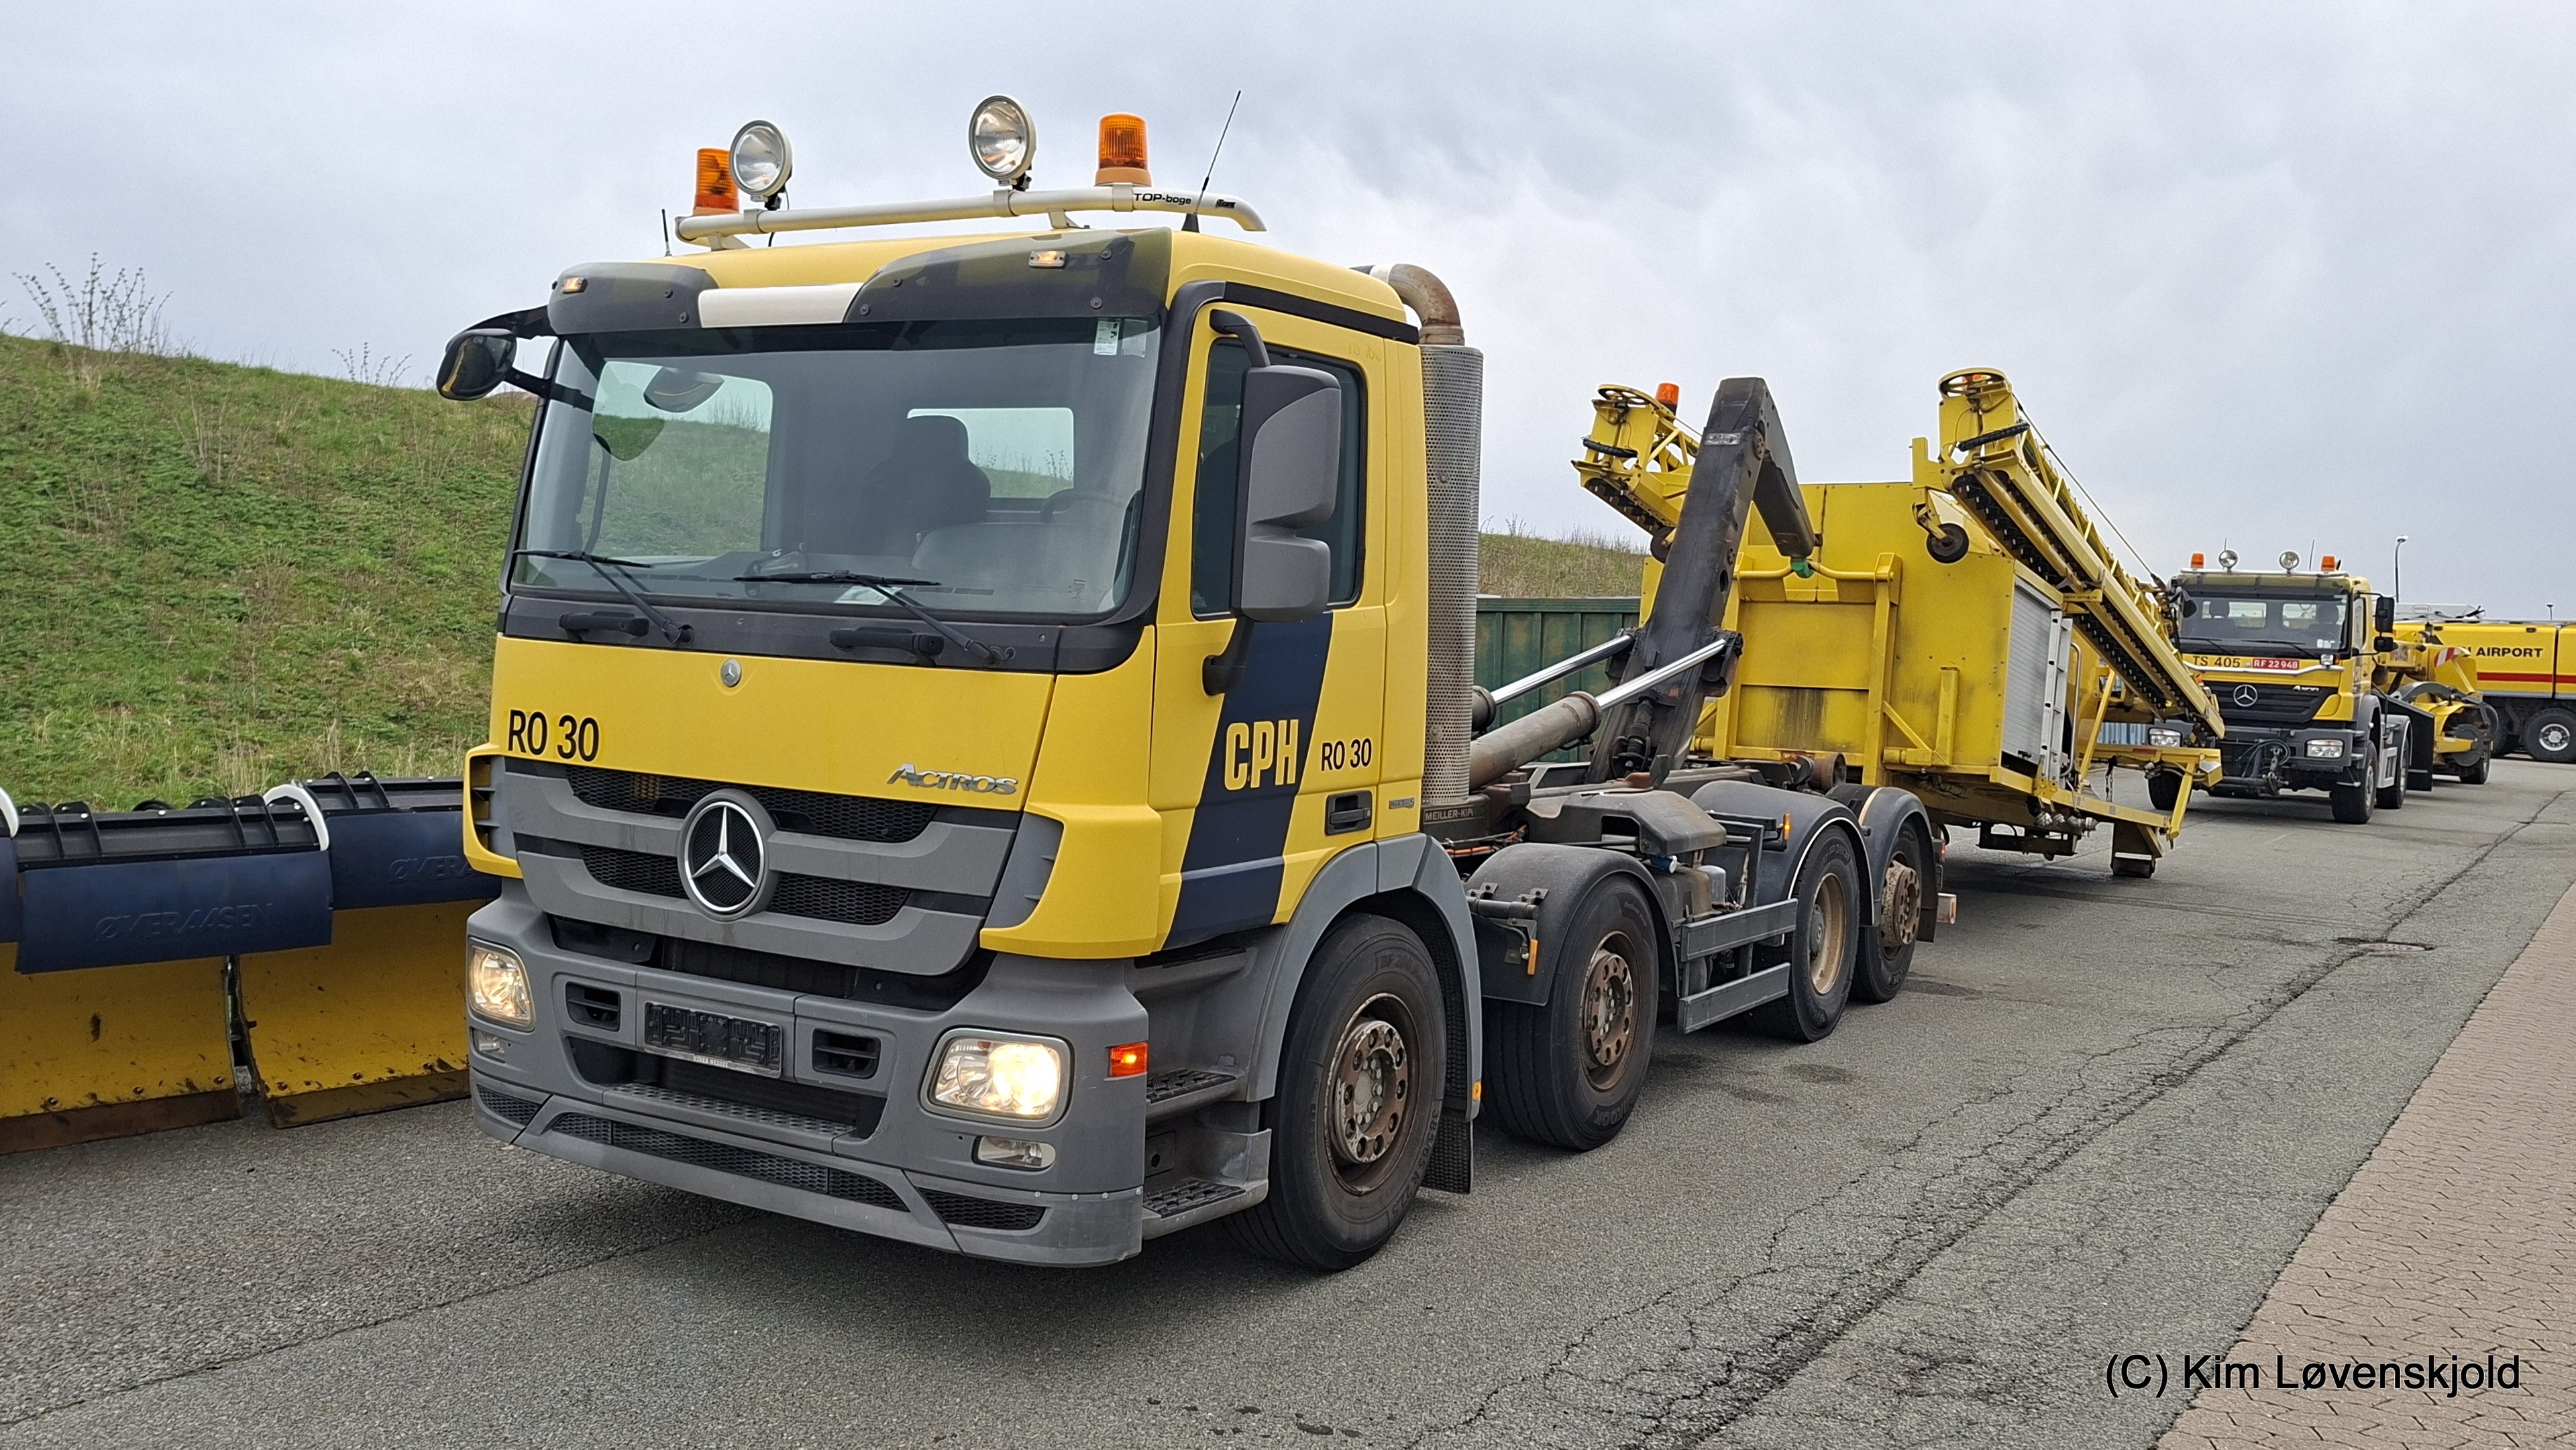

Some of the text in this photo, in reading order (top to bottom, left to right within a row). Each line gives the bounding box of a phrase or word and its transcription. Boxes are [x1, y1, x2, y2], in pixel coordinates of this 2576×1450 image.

[2192, 655, 2241, 668] TS 405
[2254, 659, 2298, 669] RF 22 948
[2475, 647, 2544, 658] AIRPORT
[508, 709, 600, 762] RO 30
[1224, 719, 1299, 791] CPH
[1321, 738, 1373, 771] RO 30
